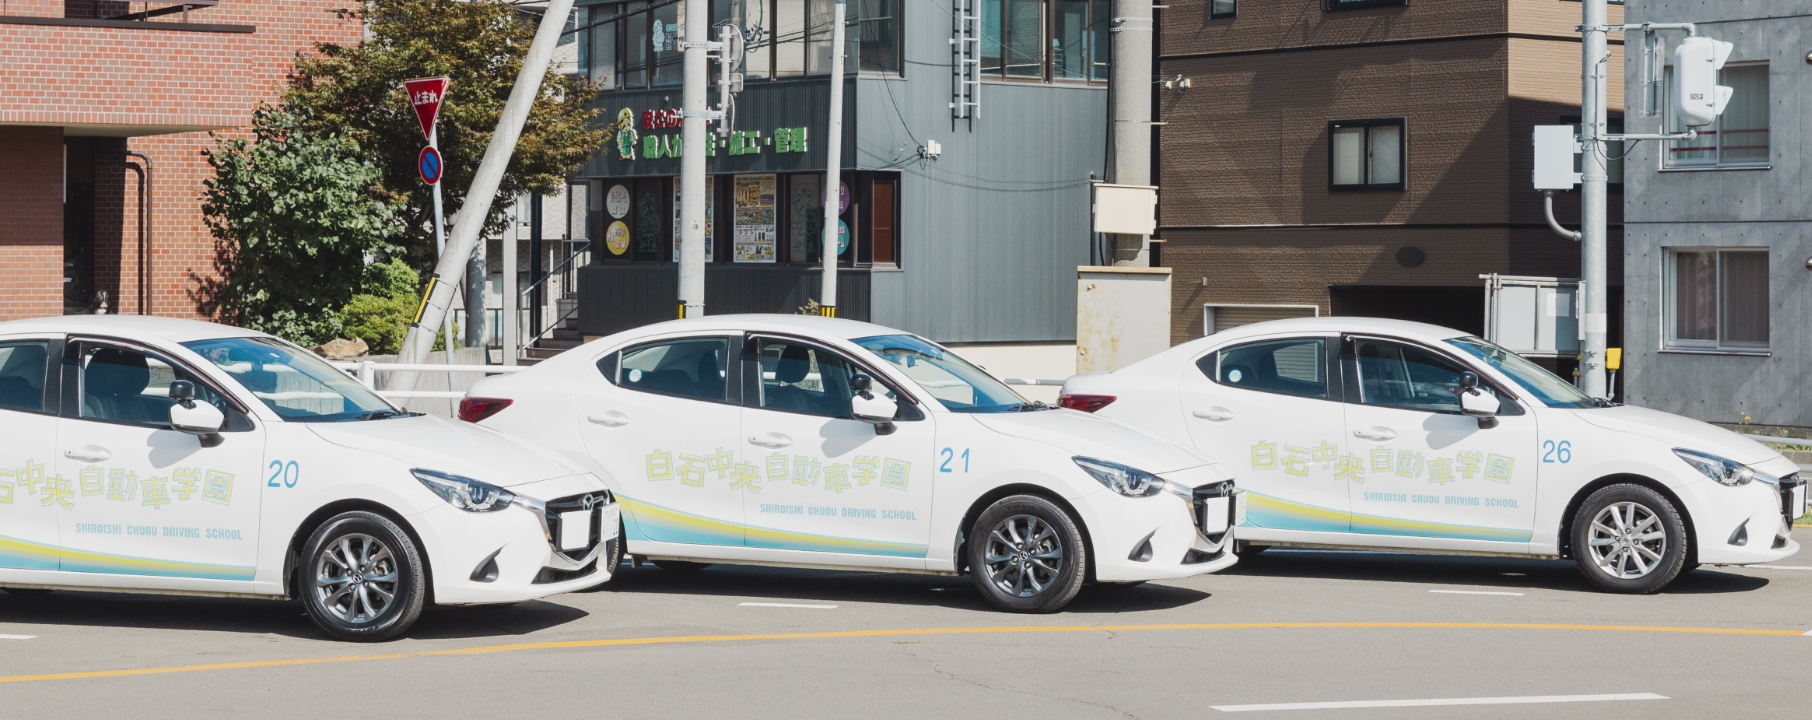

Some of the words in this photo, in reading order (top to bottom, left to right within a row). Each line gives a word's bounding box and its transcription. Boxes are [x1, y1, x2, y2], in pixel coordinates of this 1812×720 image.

[414, 90, 439, 105] 止まれ
[939, 447, 971, 473] 21
[1542, 439, 1572, 464] 26
[267, 459, 300, 489] 20
[1363, 491, 1407, 503] SHIROISHI
[1411, 494, 1440, 504] CHUOU
[1444, 496, 1480, 506] DRIVING
[1485, 497, 1519, 508] SCHOOL
[760, 503, 803, 515] SHIROISHI
[808, 506, 837, 517] CHUOU
[841, 507, 877, 519] DRIVING
[881, 509, 917, 521] SCHOOL
[75, 522, 122, 535] SHIROISHI
[127, 525, 158, 537] CHUOU
[162, 526, 201, 538] DRIVING
[205, 528, 243, 540] SCHOOL
